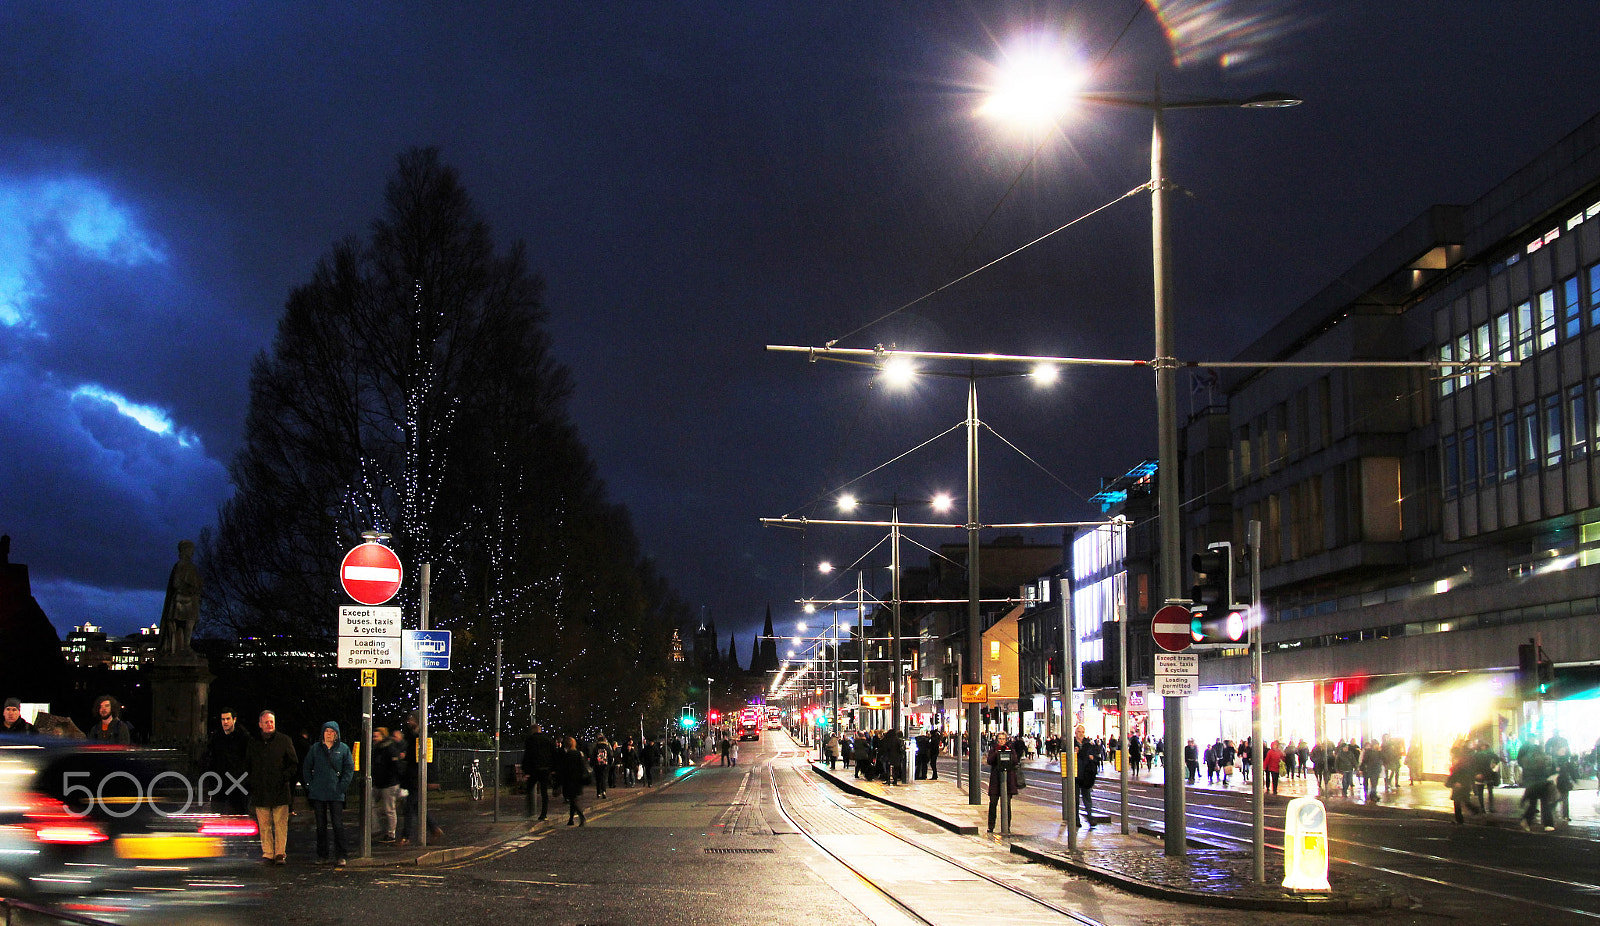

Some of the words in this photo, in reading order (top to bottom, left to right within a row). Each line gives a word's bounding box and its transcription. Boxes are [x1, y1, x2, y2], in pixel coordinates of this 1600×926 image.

[342, 609, 370, 617] Except
[354, 640, 386, 648] Loading
[350, 648, 390, 656] permitted
